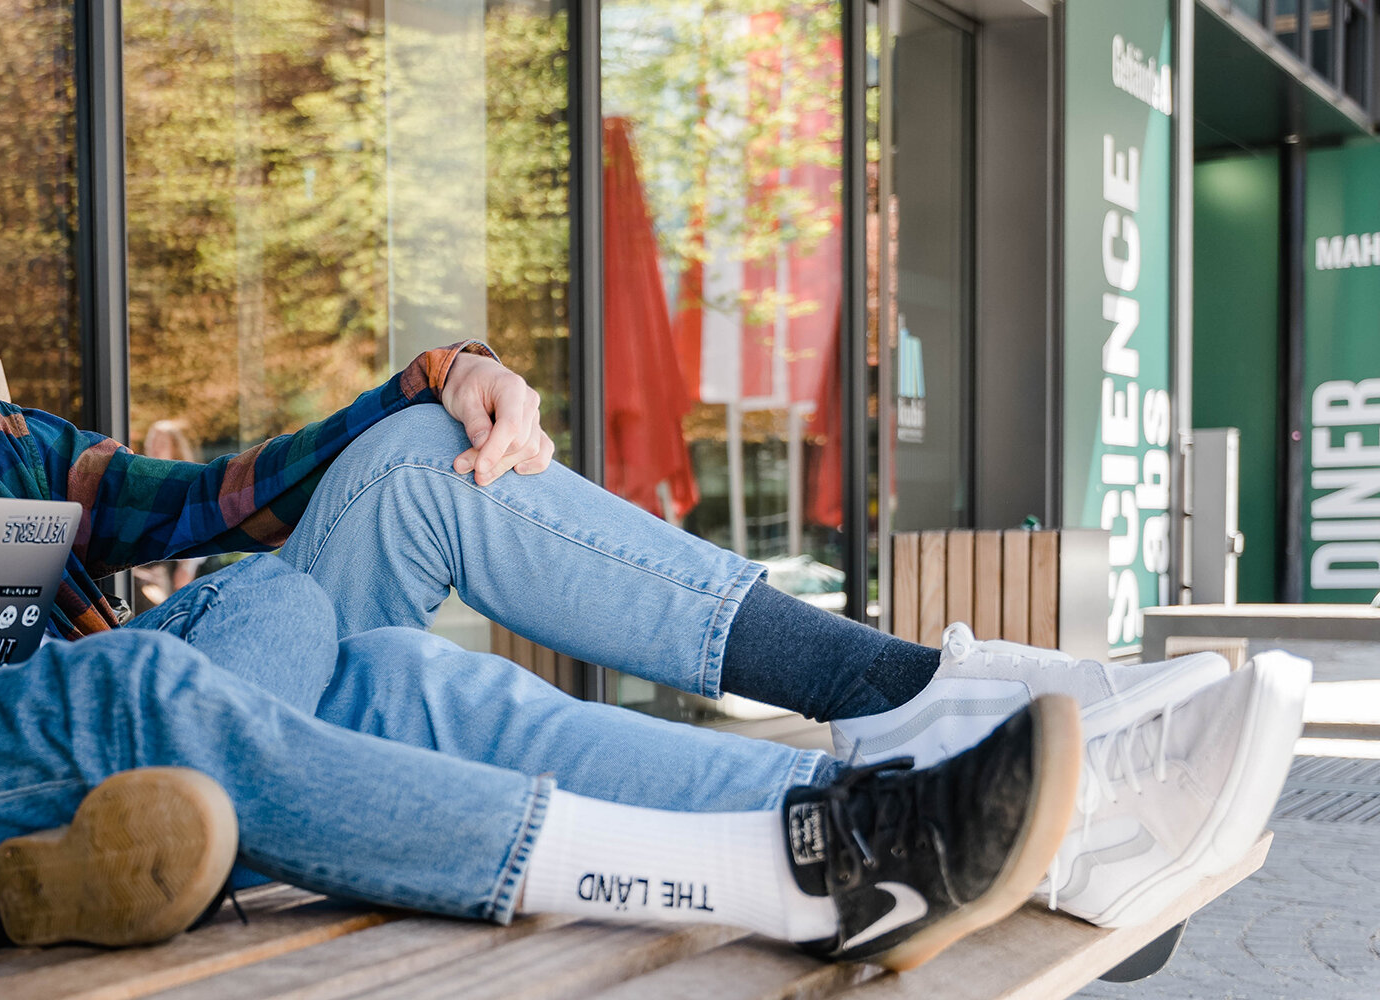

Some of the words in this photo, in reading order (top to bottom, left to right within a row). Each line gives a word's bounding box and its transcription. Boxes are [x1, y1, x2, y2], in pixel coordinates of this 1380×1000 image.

[1315, 232, 1380, 270] MAH
[1101, 133, 1144, 643] SCIENCE
[2, 522, 67, 544] VETTERLE
[577, 872, 648, 911] LÄND
[660, 881, 714, 912] THE
